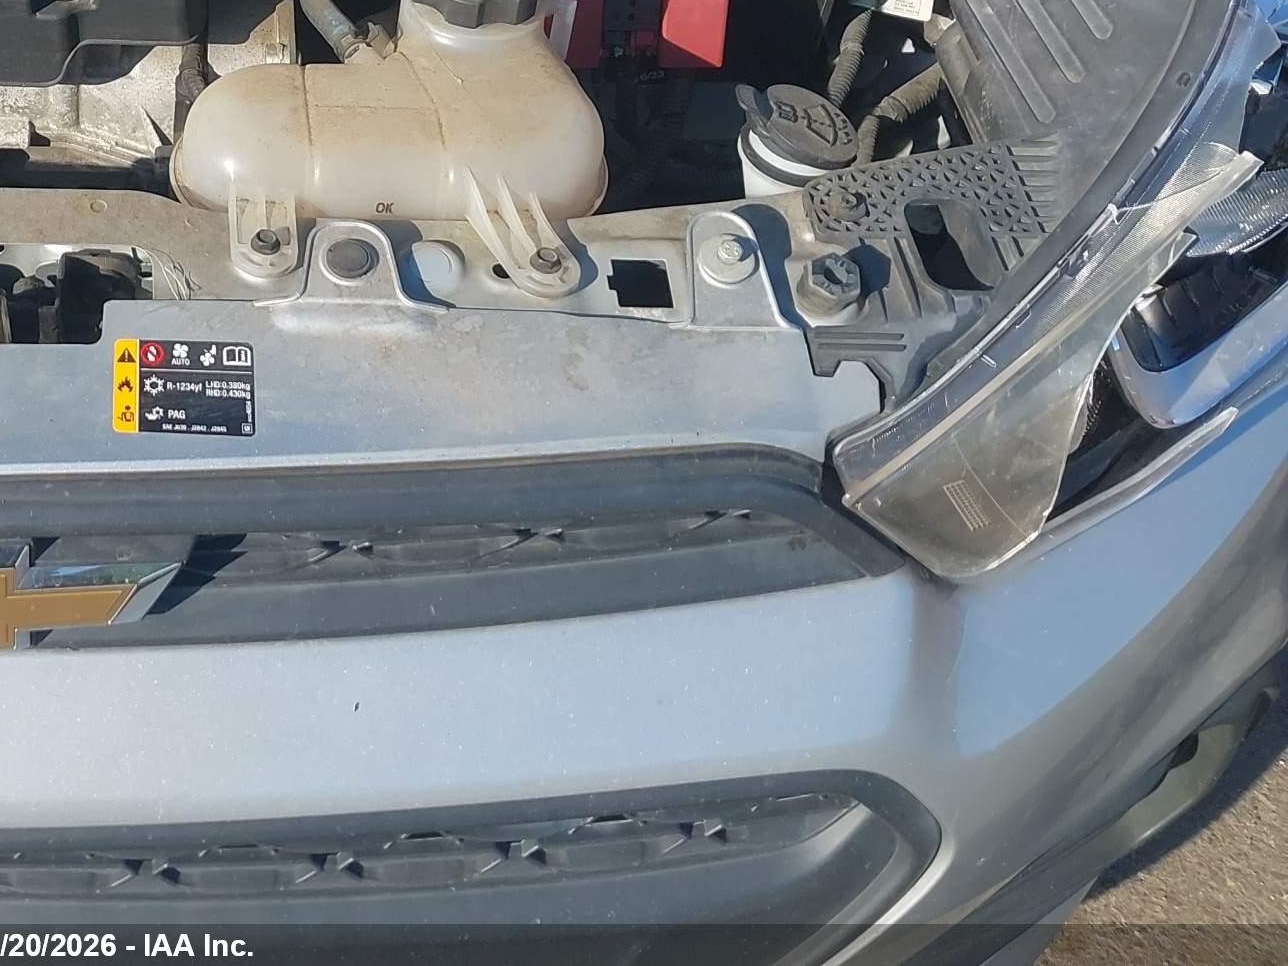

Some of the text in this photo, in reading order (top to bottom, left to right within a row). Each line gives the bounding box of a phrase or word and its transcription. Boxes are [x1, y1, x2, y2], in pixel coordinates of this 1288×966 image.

[375, 202, 394, 214] OK
[171, 357, 191, 366] AUTO
[166, 381, 203, 393] R-1234yf
[167, 409, 186, 420] PAG
